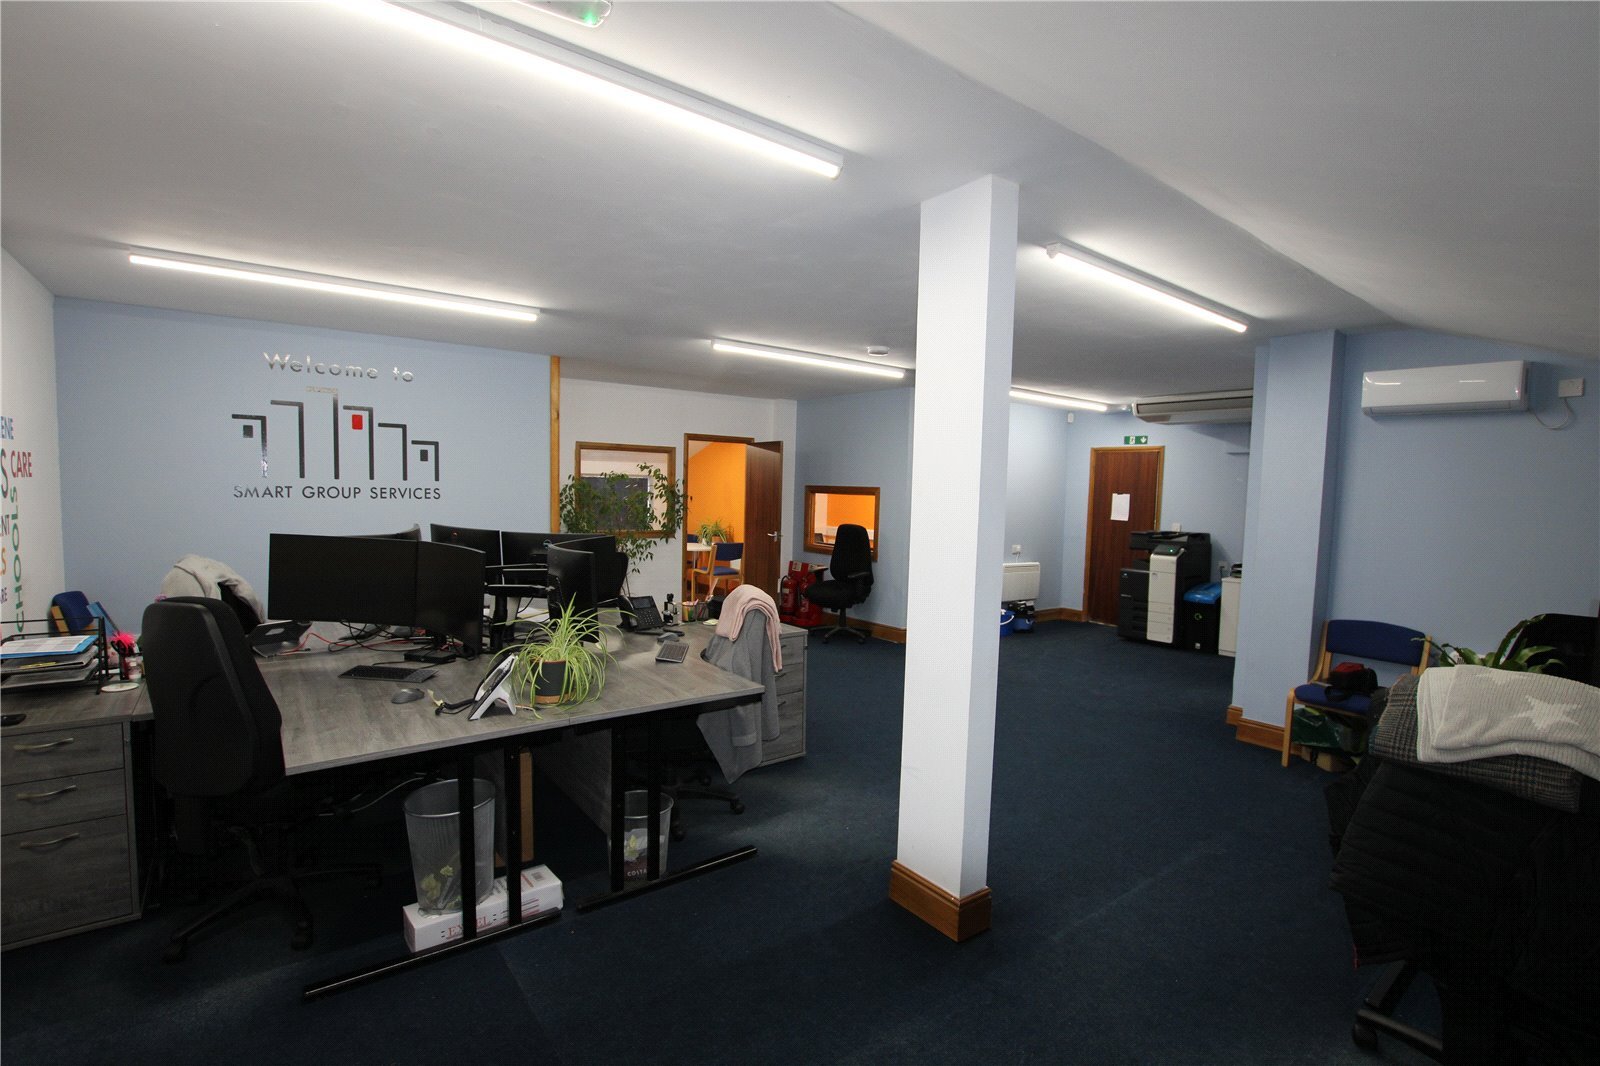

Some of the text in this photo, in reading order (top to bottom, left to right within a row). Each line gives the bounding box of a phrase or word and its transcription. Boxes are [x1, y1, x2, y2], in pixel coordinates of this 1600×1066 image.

[263, 352, 414, 382] Welcome to
[11, 450, 33, 478] CARE
[233, 485, 441, 500] SMART GROUP SERVICES
[0, 514, 9, 536] NT
[10, 486, 24, 639] CHOOLS
[449, 916, 489, 938] EXEL
